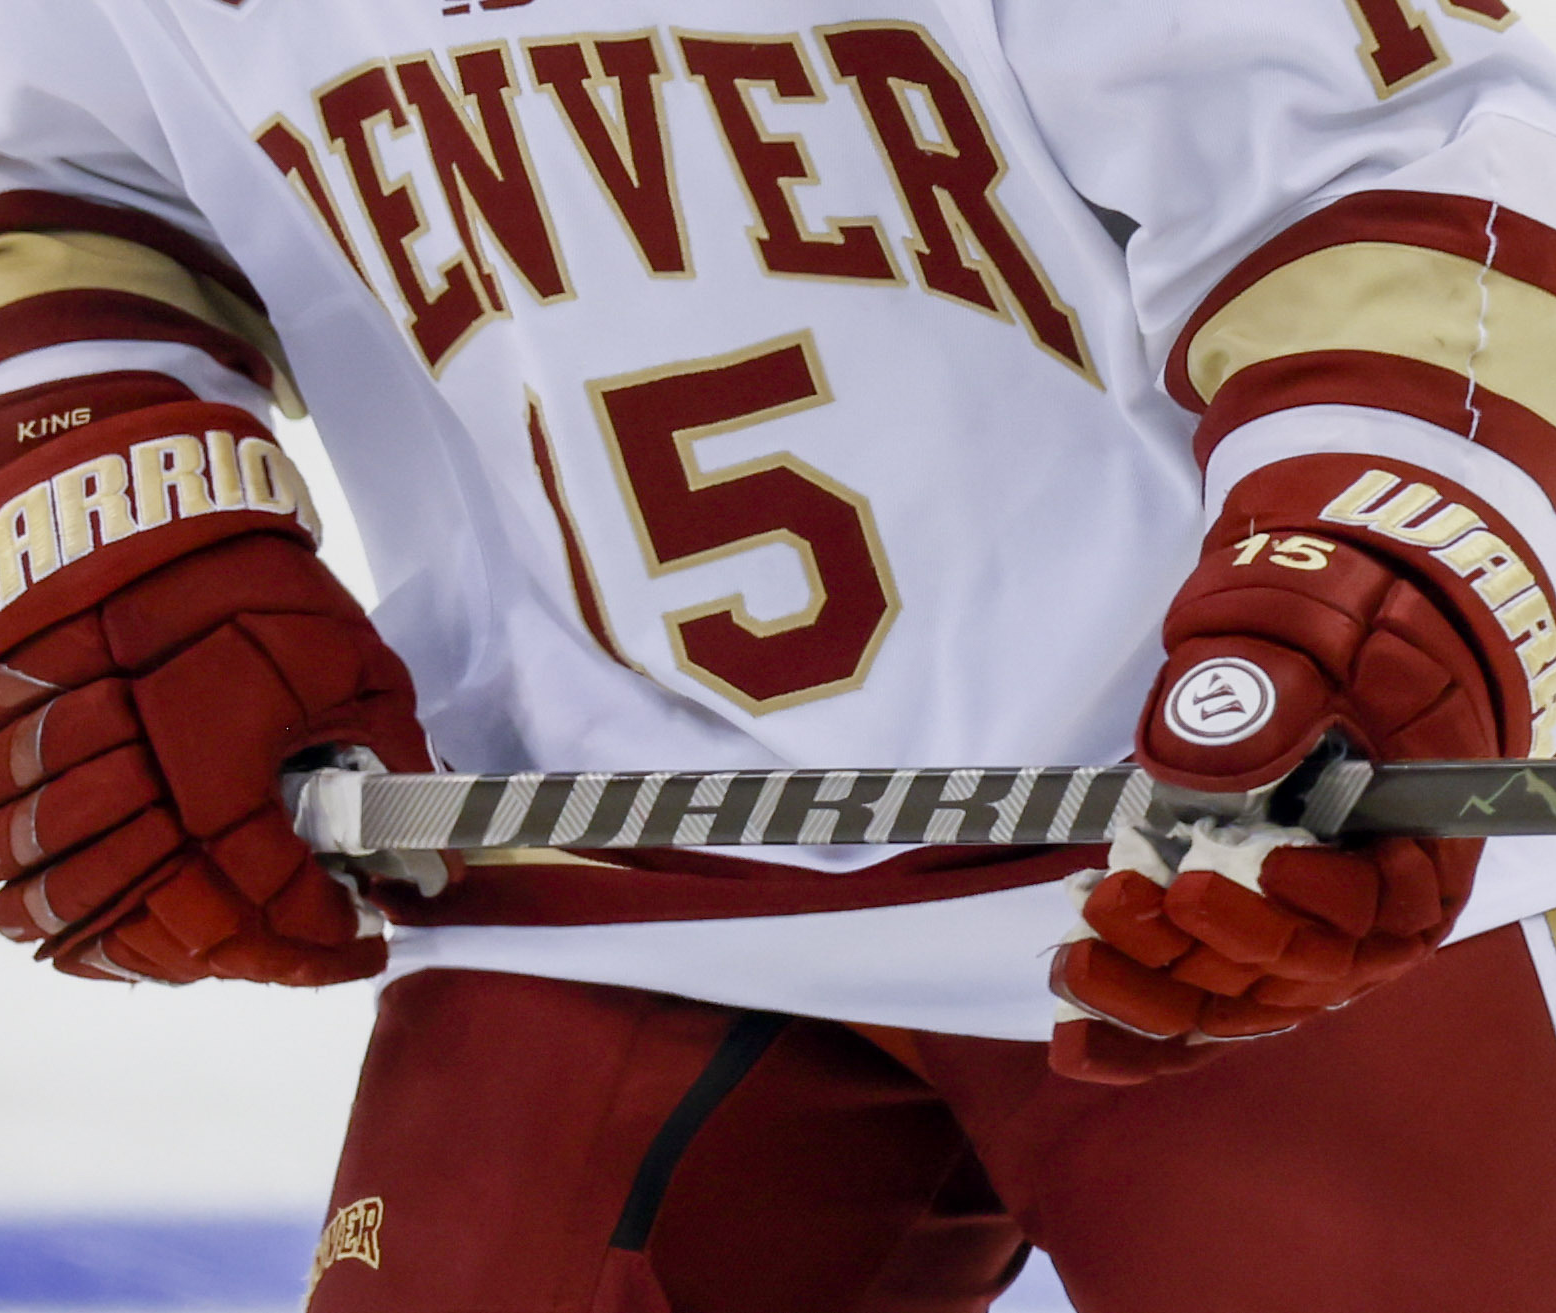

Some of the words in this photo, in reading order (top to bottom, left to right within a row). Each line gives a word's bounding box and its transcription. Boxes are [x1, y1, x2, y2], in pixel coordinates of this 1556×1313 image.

[17, 407, 92, 443] KING
[523, 329, 903, 717] 5
[1232, 533, 1337, 570] 15
